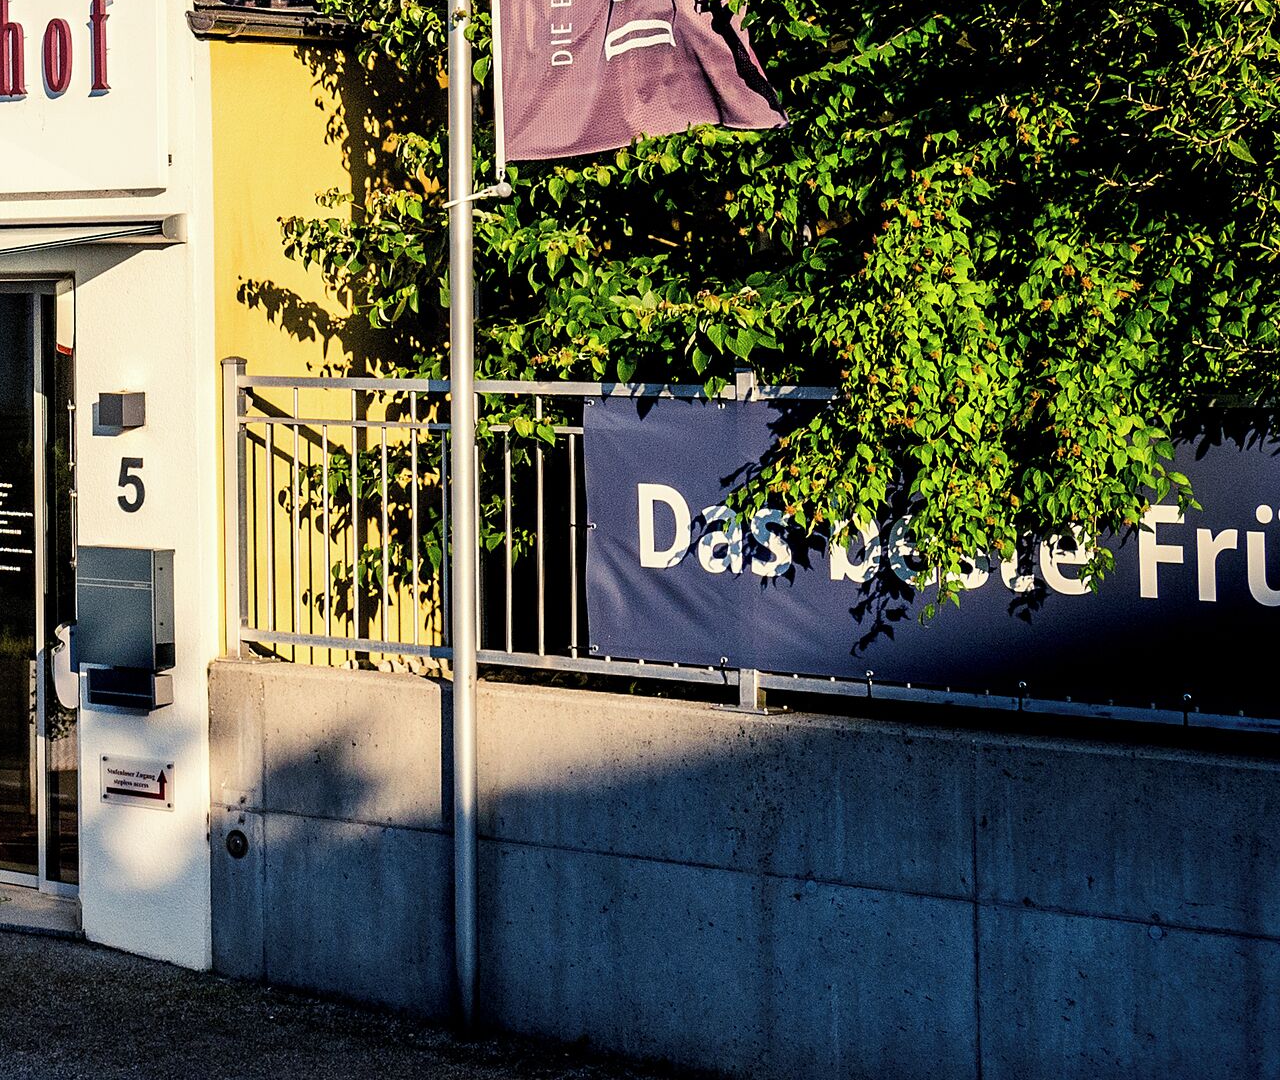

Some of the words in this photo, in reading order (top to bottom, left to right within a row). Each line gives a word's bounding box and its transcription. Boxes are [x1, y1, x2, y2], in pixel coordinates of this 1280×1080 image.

[117, 457, 146, 513] 5
[637, 483, 793, 577] Das
[135, 771, 156, 781] Zugang
